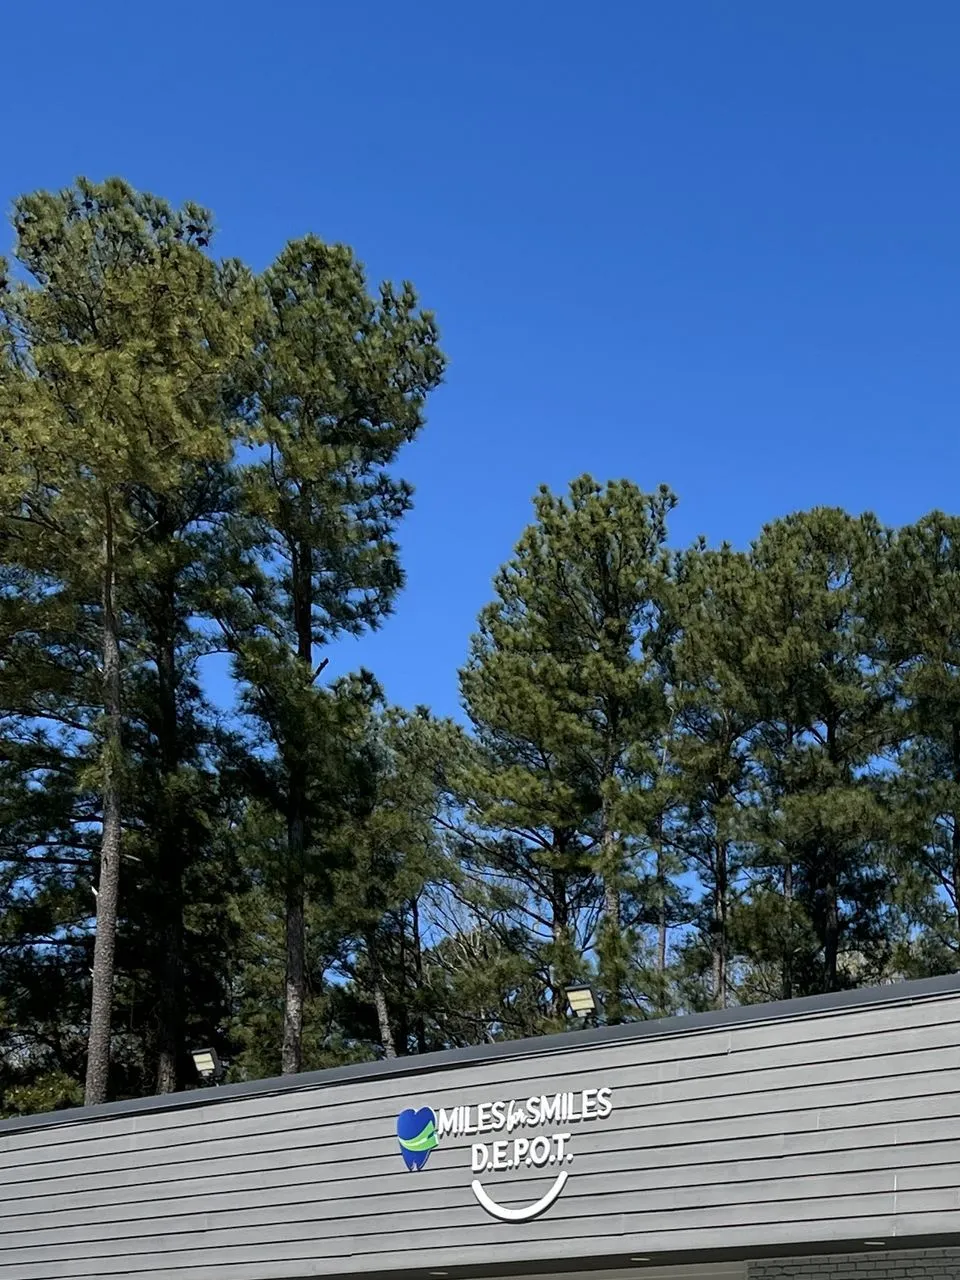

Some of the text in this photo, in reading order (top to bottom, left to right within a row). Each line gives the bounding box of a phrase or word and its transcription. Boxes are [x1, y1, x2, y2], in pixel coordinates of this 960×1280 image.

[437, 1087, 613, 1134] MILES for SMILES
[471, 1132, 574, 1172] D.E.P.O.T.
